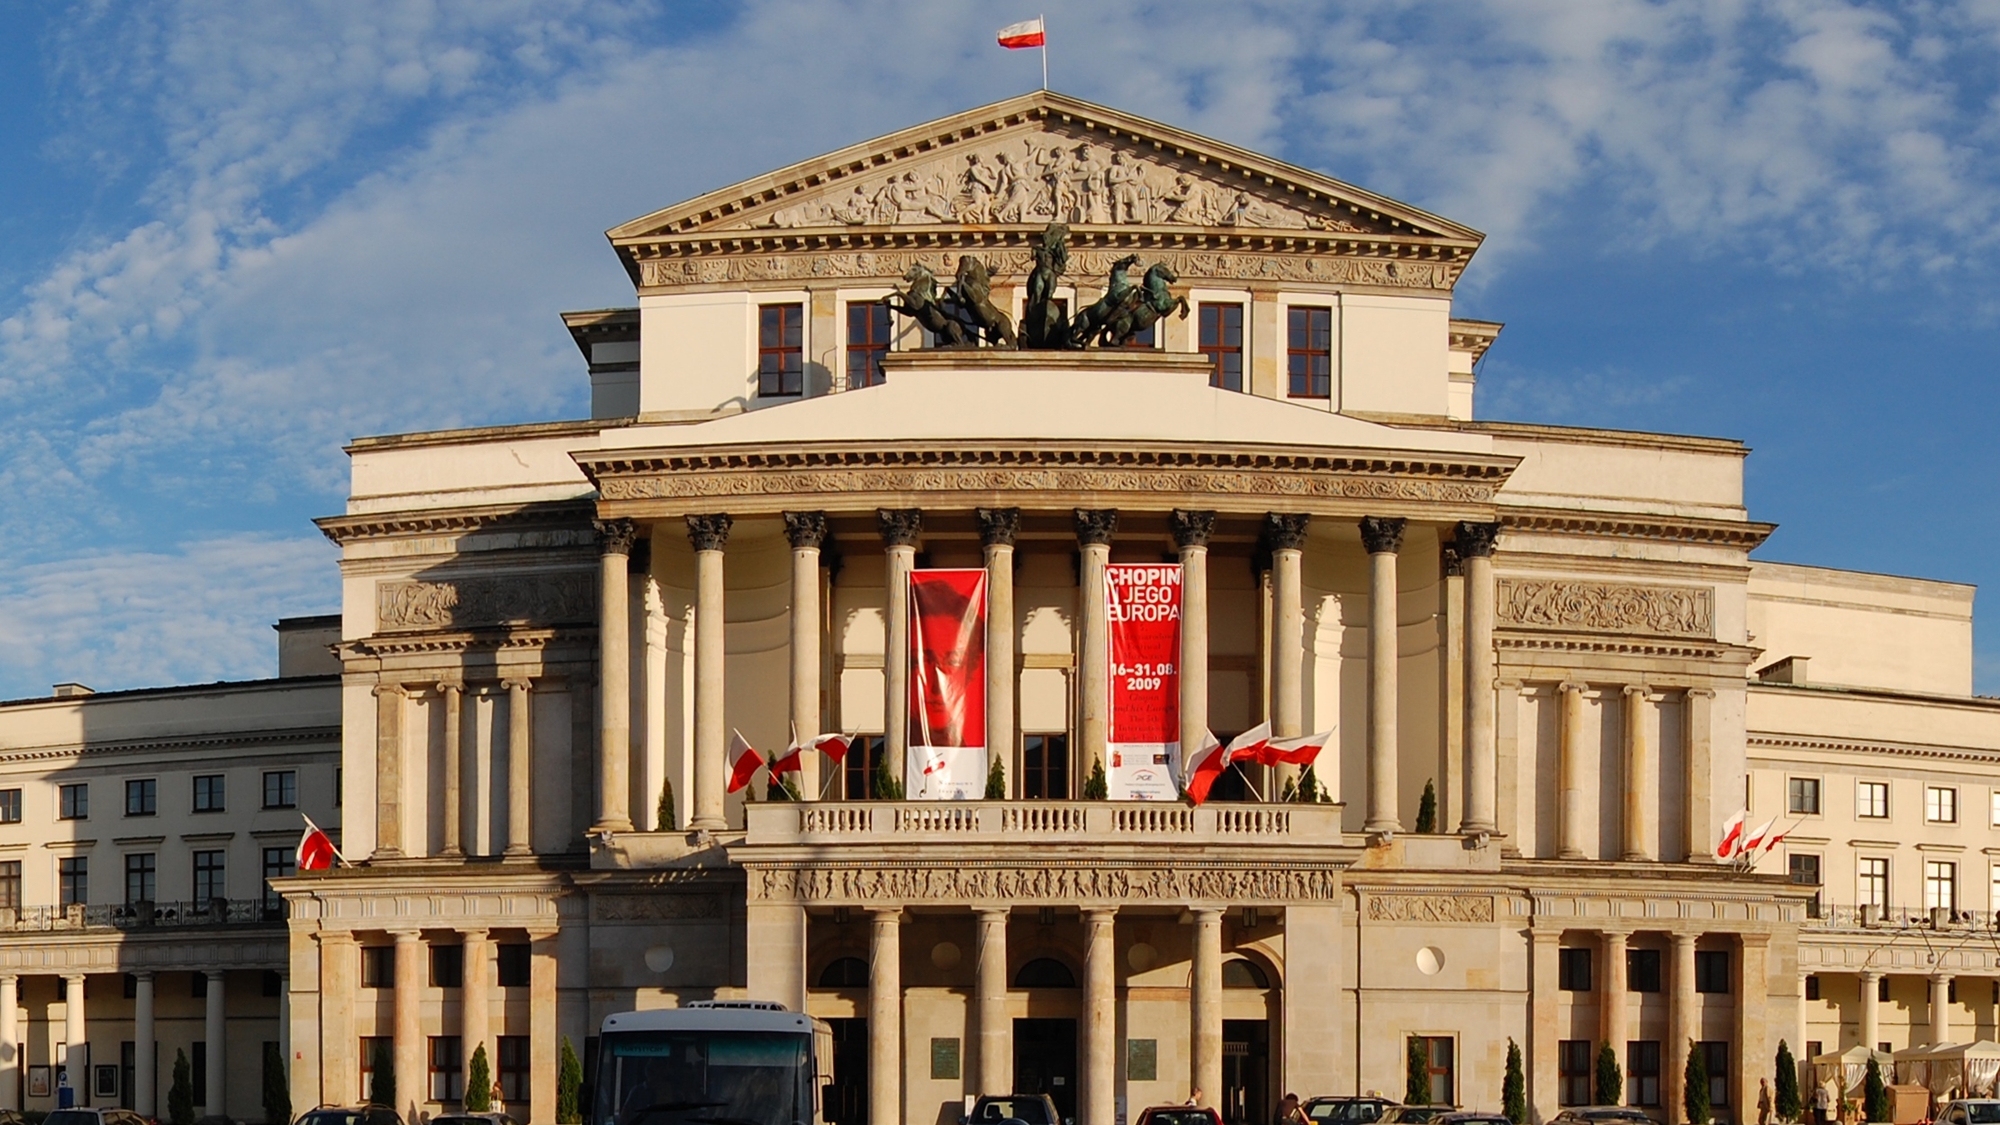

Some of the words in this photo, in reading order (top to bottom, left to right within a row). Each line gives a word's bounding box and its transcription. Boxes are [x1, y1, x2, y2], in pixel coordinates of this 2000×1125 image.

[1106, 568, 1180, 586] CHOPIN
[1123, 586, 1172, 604] JEGO
[1107, 604, 1181, 622] EUROPA
[1127, 677, 1161, 691] 2009
